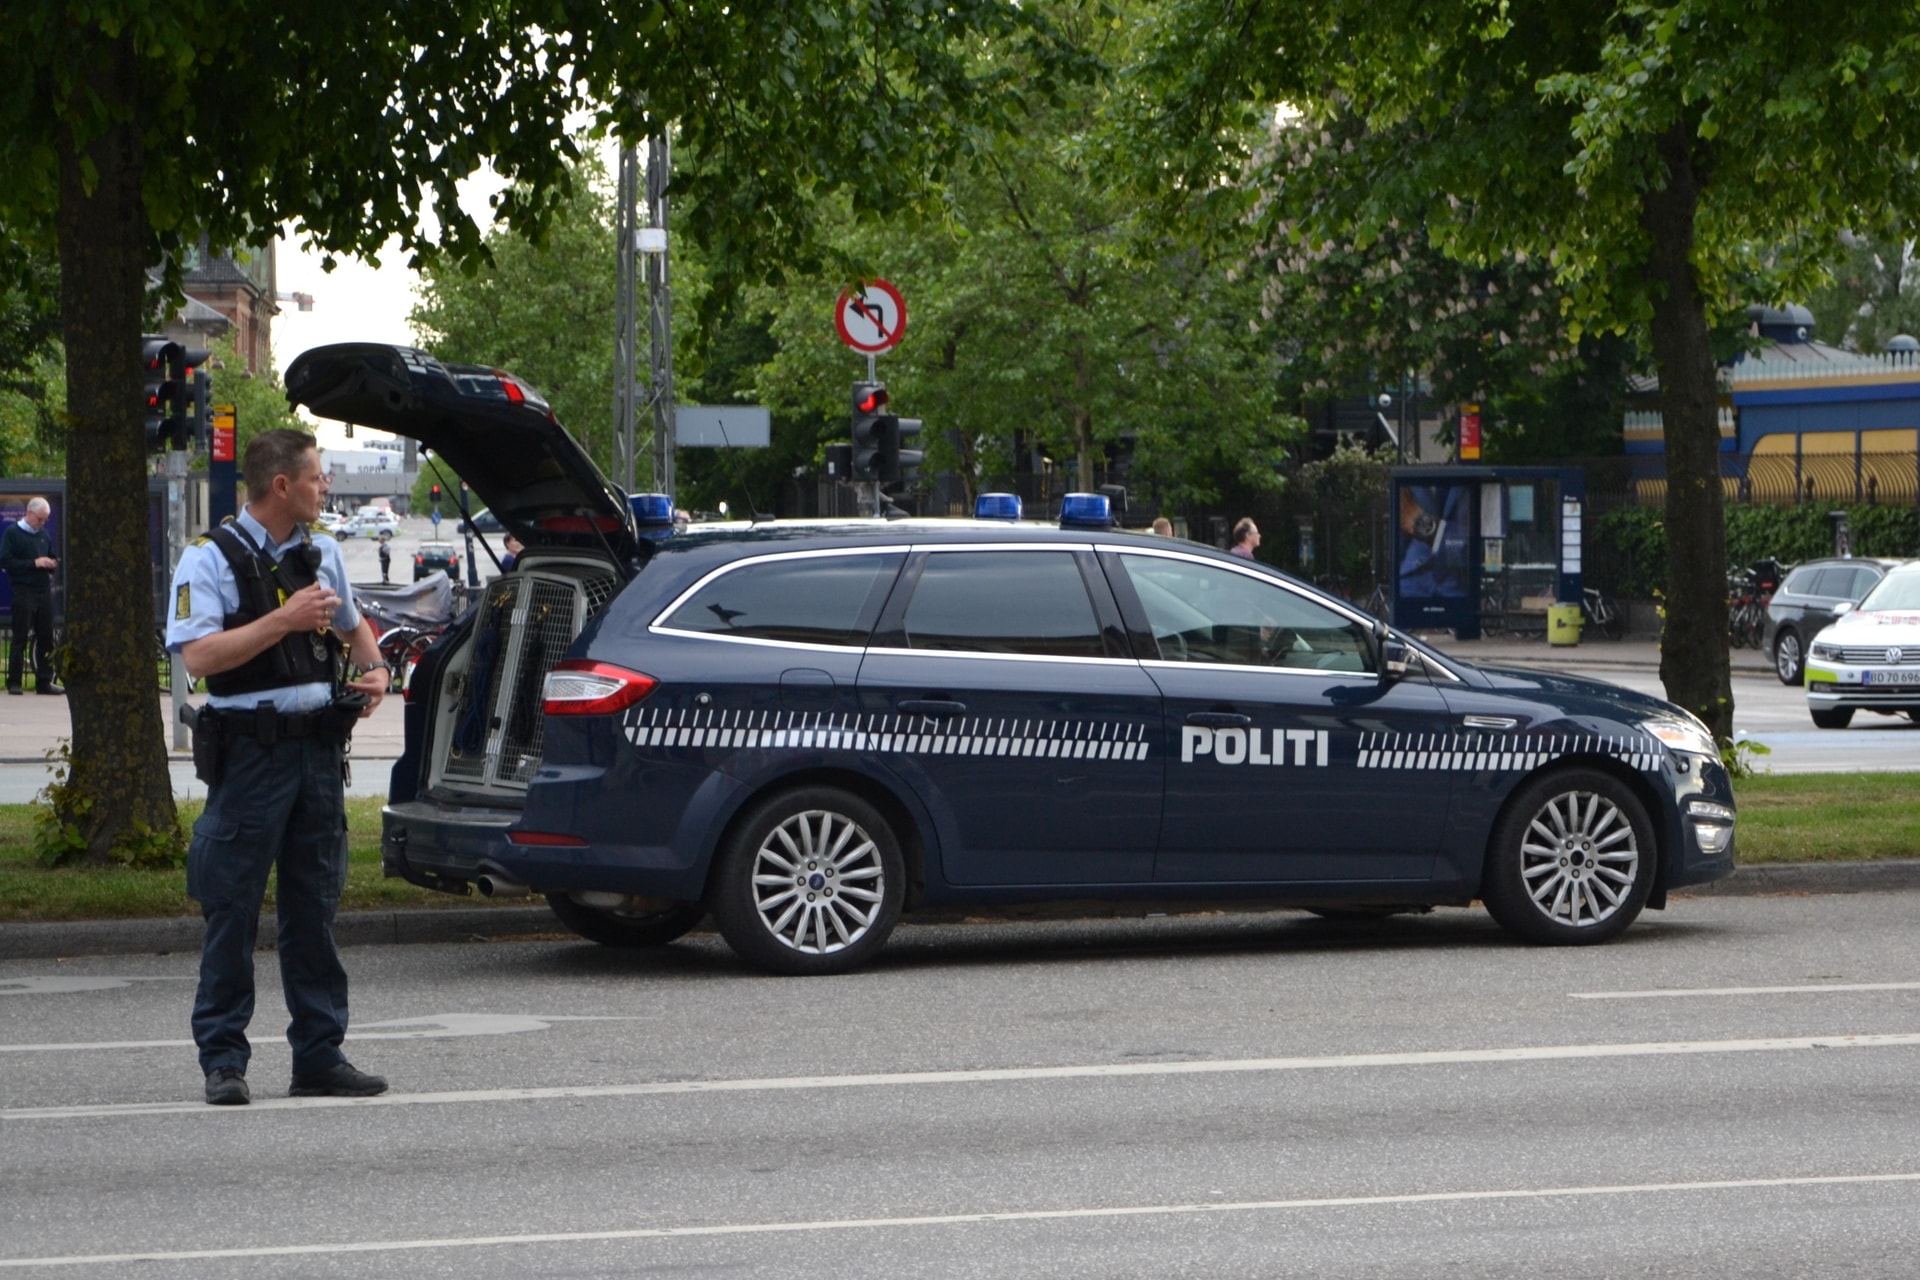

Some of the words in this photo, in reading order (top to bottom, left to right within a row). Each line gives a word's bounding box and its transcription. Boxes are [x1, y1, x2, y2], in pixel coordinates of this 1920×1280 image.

[1871, 672, 1884, 682] BD
[1887, 672, 1899, 682] 70
[1901, 672, 1920, 682] 696
[1181, 725, 1328, 767] POLITI
